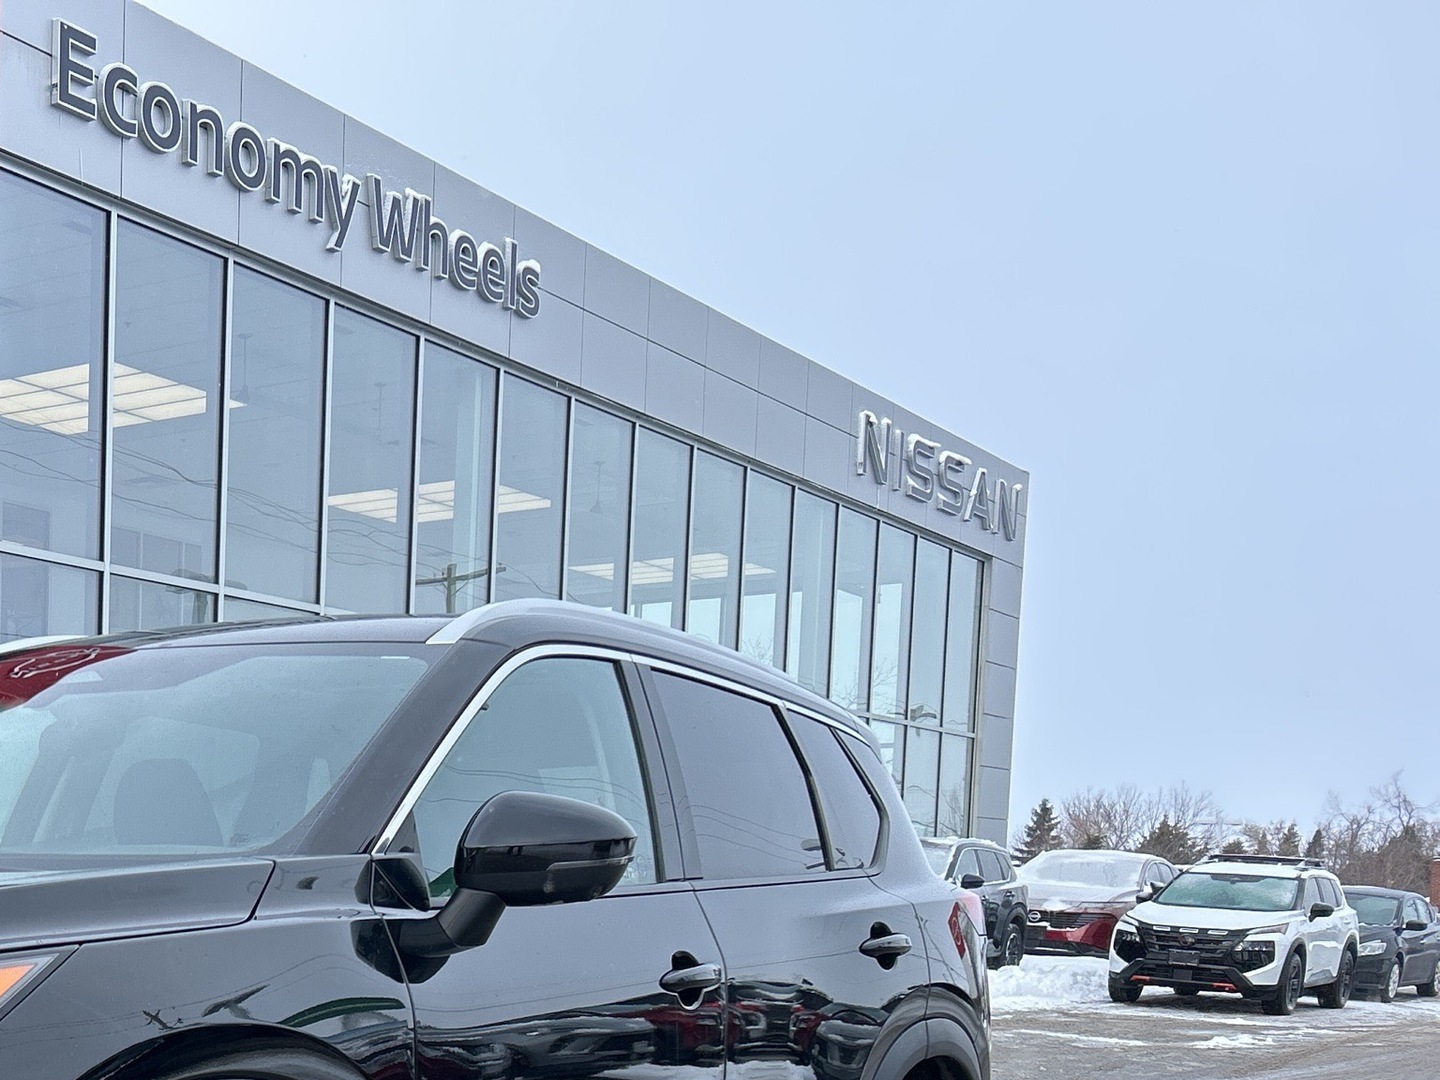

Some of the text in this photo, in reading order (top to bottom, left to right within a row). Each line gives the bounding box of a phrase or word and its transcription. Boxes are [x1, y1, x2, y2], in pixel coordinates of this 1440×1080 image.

[51, 17, 541, 319] Economy Wheels
[856, 410, 1023, 542] NISSAN
